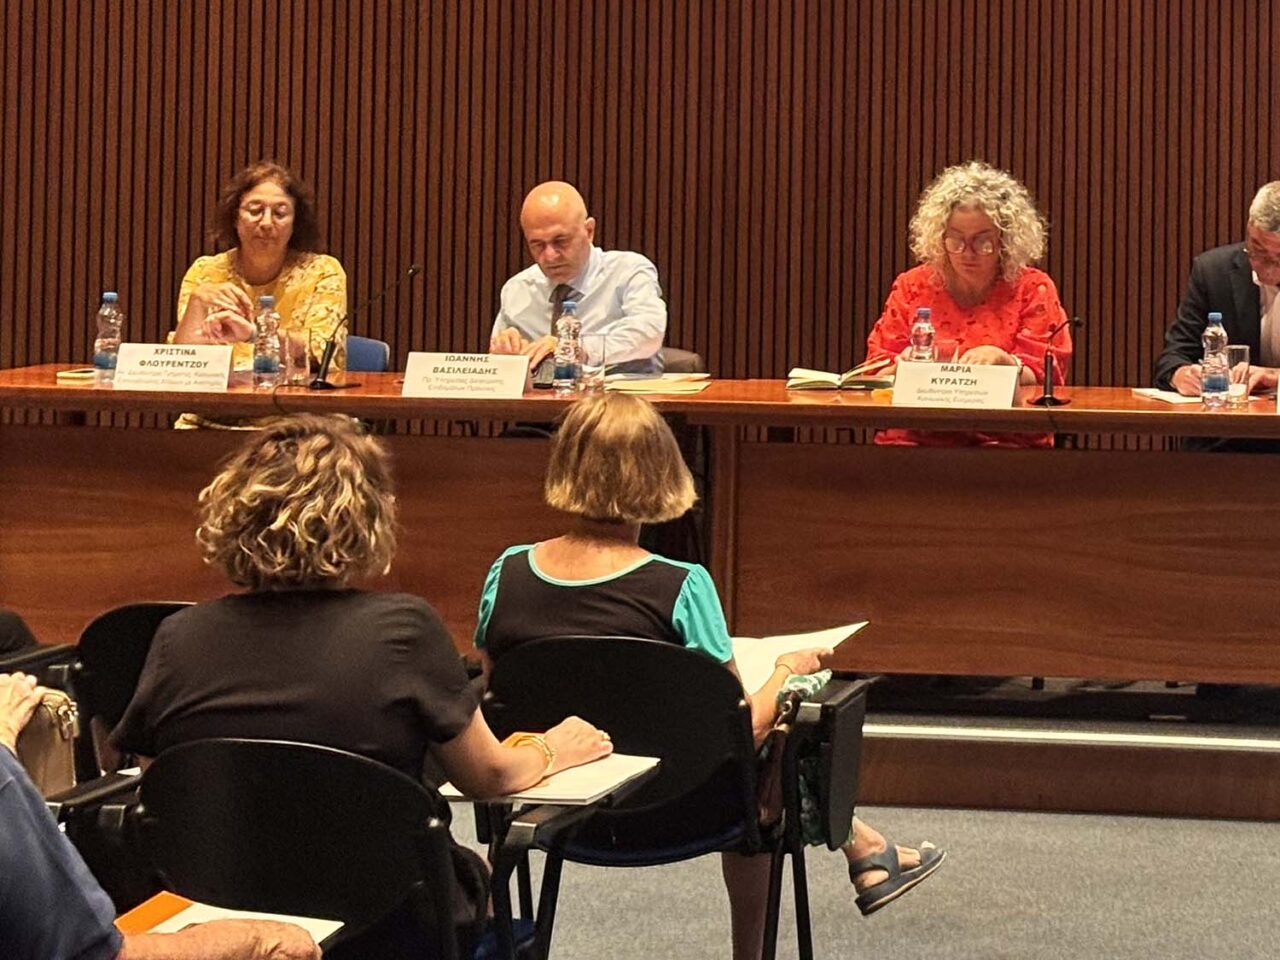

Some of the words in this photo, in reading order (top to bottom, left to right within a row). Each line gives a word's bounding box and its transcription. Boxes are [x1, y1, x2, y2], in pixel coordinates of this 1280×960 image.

[153, 348, 197, 356] ΧΡΙΣΤΙΝΑ
[444, 355, 490, 363] ΙΩΑΝΝΗΣ
[138, 360, 209, 369] ΦΛΟΥΡΕΝΤΖΟΥ
[432, 366, 499, 375] ΒΑΣΙΛΕΙΑΔΗΣ
[940, 365, 972, 373] ΜΑΡΙΑ
[930, 377, 978, 386] ΚΥΡΑΤΖΗ
